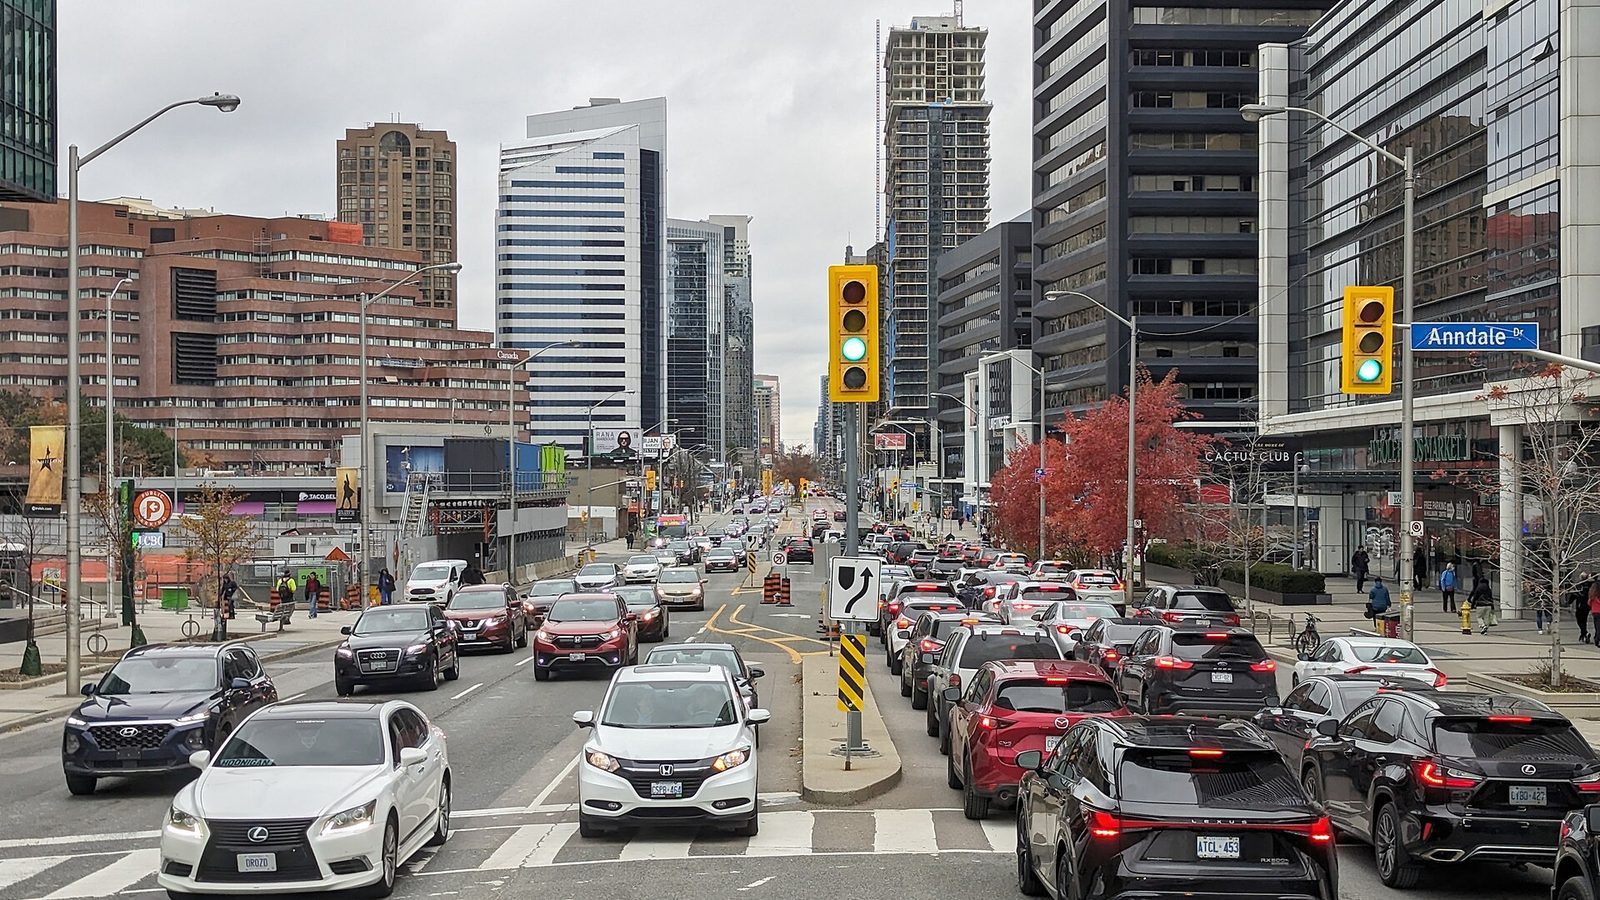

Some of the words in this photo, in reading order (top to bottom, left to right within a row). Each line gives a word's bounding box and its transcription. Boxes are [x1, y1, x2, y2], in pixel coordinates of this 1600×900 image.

[1428, 327, 1506, 345] Anndale
[497, 350, 519, 360] Canada
[1424, 434, 1462, 461] MARKET
[1205, 451, 1255, 462] CACTUS
[1259, 451, 1290, 461] CLUB
[220, 758, 274, 767] HOONIGAN
